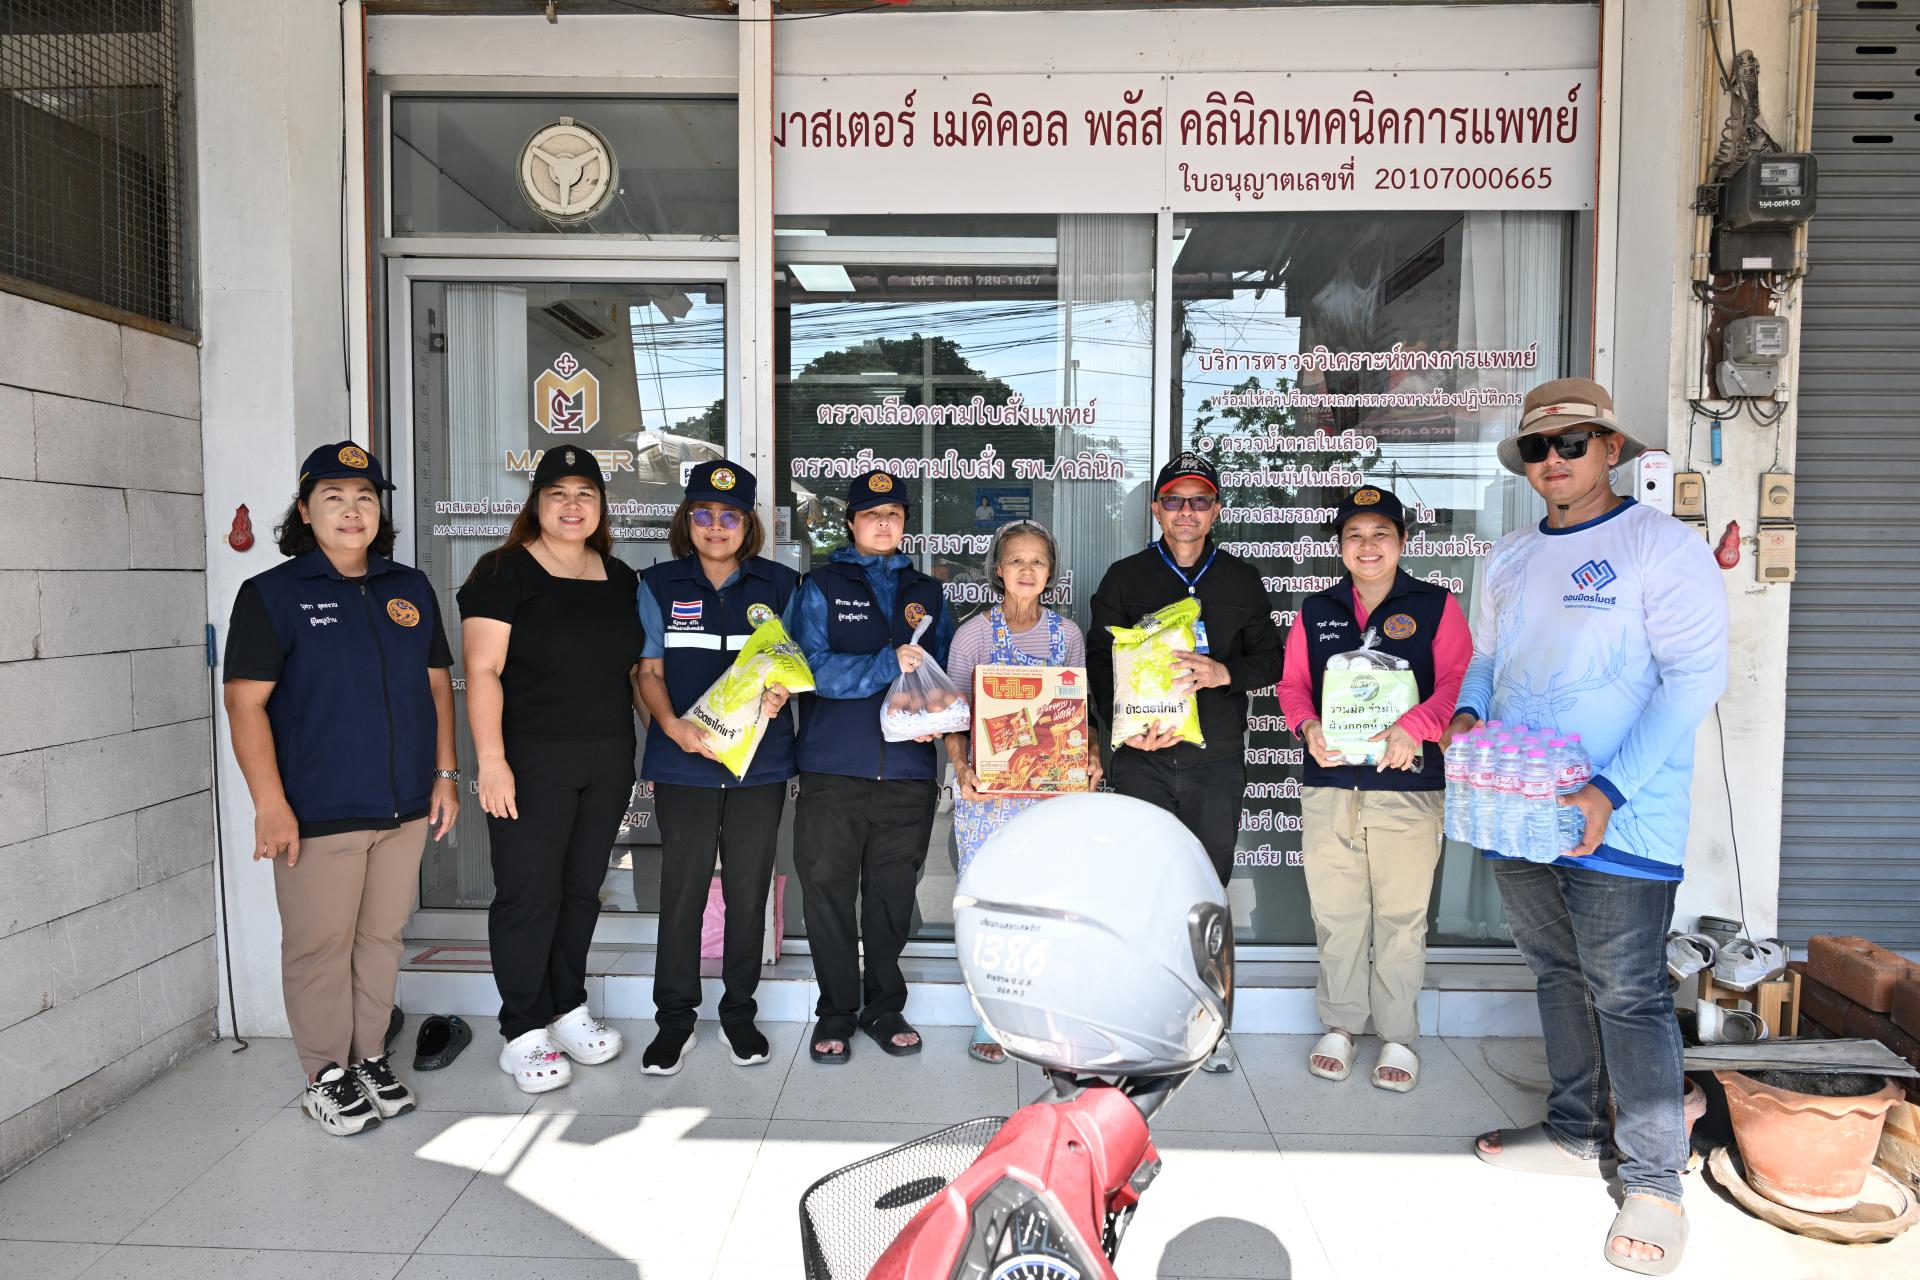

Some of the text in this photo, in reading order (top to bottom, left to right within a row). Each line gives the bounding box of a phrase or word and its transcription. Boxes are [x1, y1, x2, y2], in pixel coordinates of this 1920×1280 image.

[933, 92, 1068, 147] เมดิคอล
[1084, 88, 1163, 146] พลัส
[1180, 83, 1582, 146] คลินิกเทคนิคการแพทย์
[1178, 155, 1553, 201] ใบอนุญาตเลขที่ 20107000665
[1198, 342, 1537, 371] บริการตรวจวิเคราะห์ทางการแพทย์
[816, 391, 1098, 427] ตรวจเลือดตามใบสั่งแพทย์
[1210, 388, 1524, 411] พร้อมให้คำปรึกษาผลการตรวจทางห้องปฏิบัติการ
[1221, 424, 1377, 452] ตรวจน้ำตาลในเลือด
[790, 444, 1125, 480] ตรวจเลือดตามใบสั่ง รพ./คลินิก
[1220, 464, 1364, 487] ตรวจไขมันในเลือด
[435, 496, 489, 514] มาสเตอร์
[1220, 506, 1340, 524] ตรวจสมรรถภา
[433, 524, 511, 537] MASTER MEDIC
[900, 533, 994, 555] การเจาะ
[1236, 844, 1281, 866] ลาเรีย
[972, 931, 1053, 977] 1386
